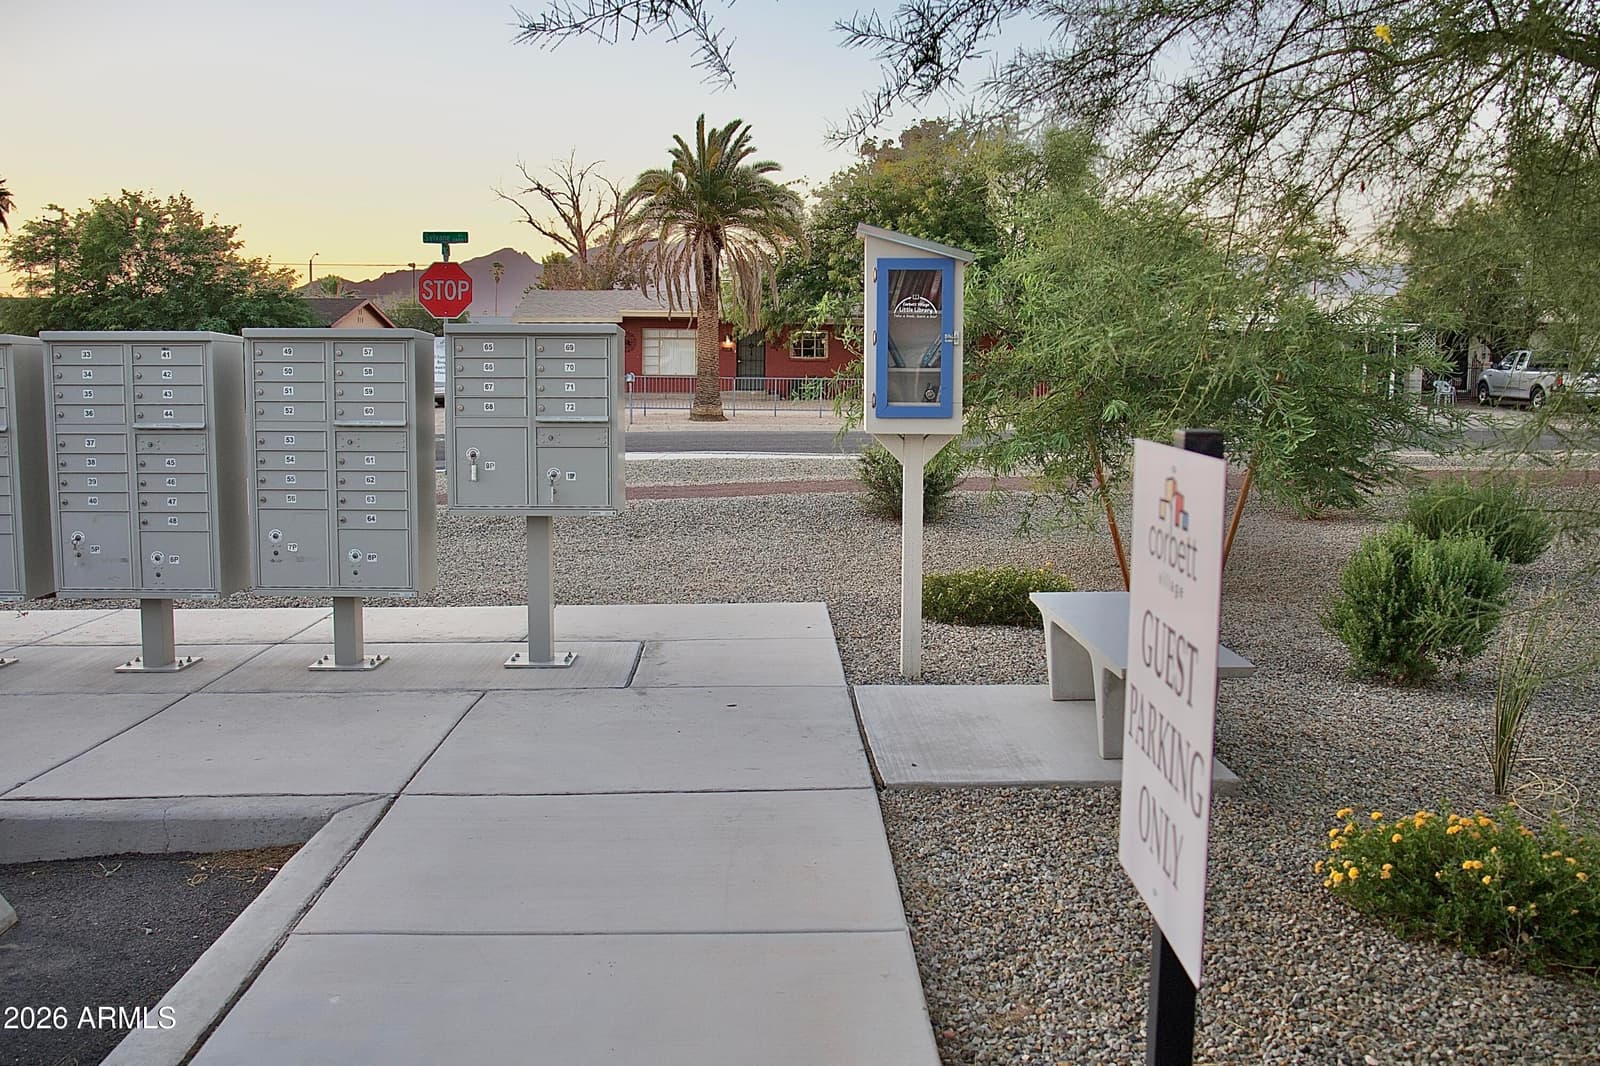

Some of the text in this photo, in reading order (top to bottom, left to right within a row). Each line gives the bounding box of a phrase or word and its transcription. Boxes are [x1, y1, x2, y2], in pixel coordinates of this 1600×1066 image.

[422, 280, 469, 300] STOP
[1149, 521, 1198, 581] corbett
[1158, 574, 1184, 599] village
[1142, 610, 1198, 706] GUEST
[1128, 684, 1204, 818] PARKING
[1138, 785, 1184, 889] ONLY
